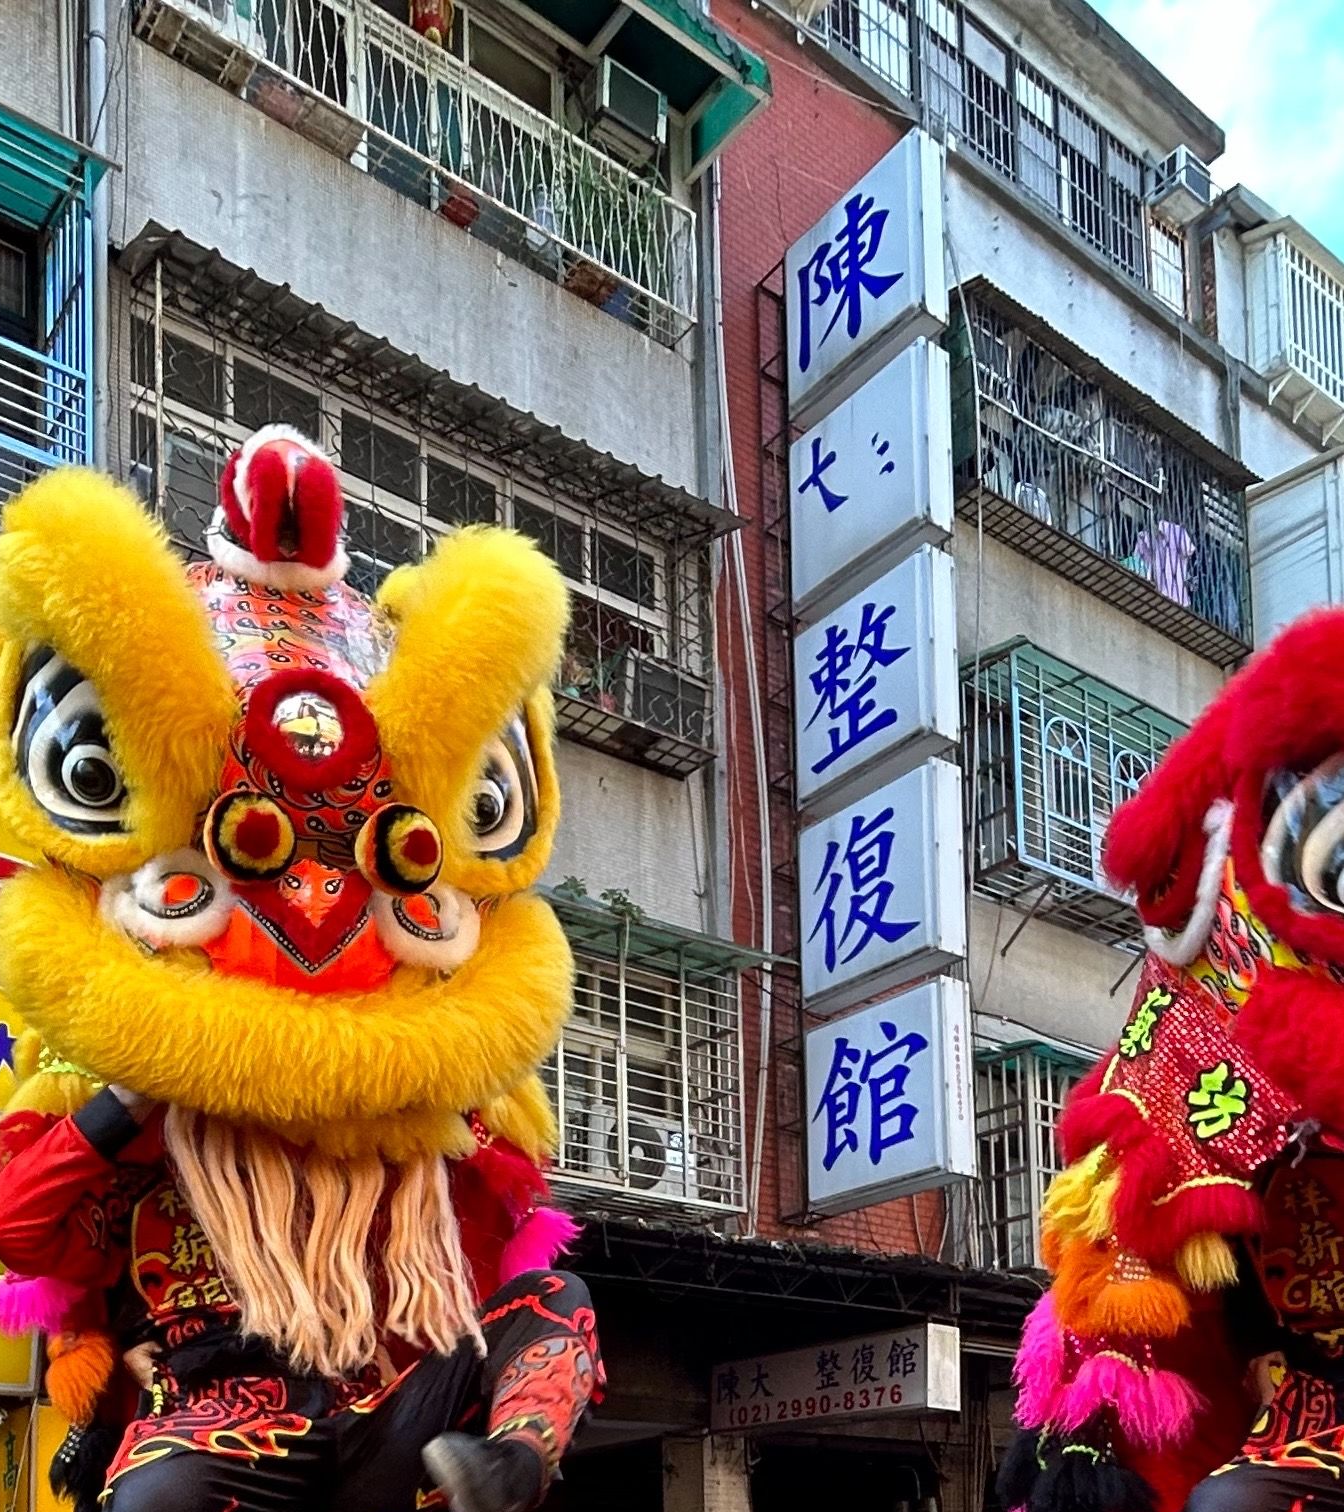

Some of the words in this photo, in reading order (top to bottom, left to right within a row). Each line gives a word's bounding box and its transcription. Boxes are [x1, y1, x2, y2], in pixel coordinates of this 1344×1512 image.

[815, 1339, 920, 1391] 整復館
[728, 1384, 904, 1426] (02)2990-8376
